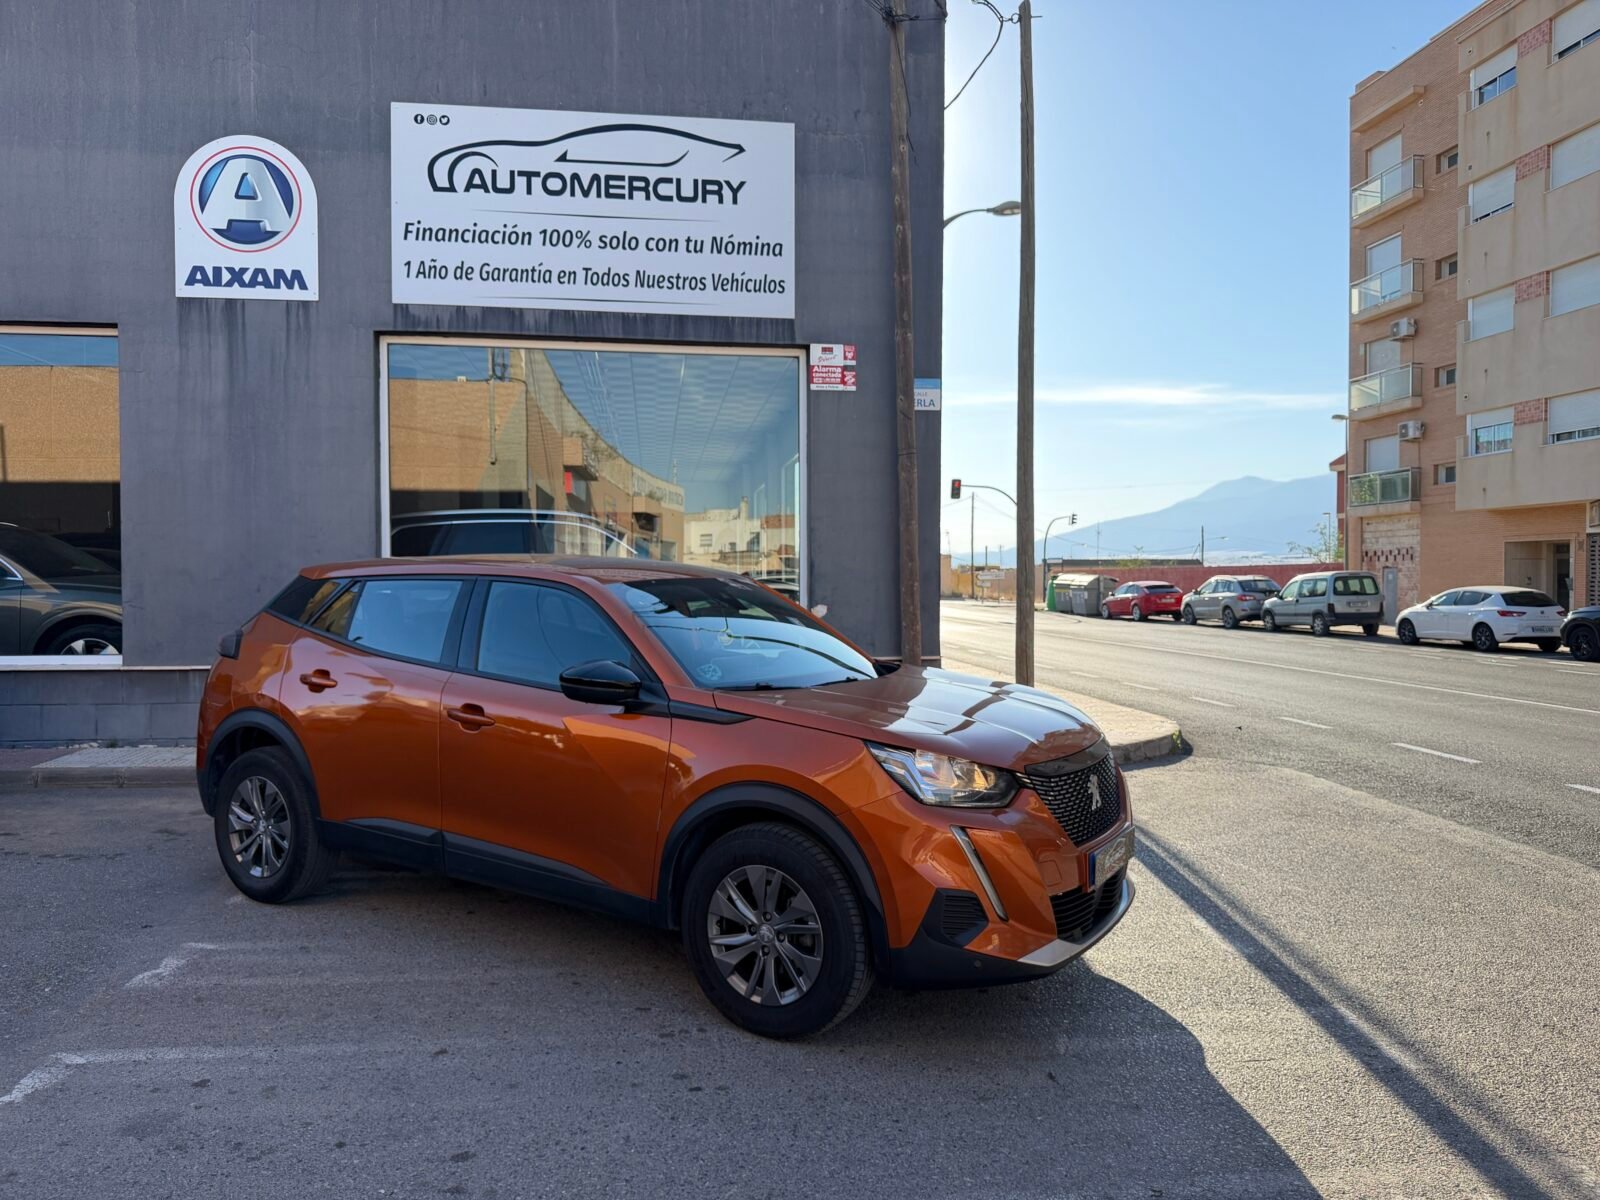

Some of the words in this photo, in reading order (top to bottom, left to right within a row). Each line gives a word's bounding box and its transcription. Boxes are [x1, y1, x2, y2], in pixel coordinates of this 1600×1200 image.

[463, 167, 747, 206] AUTOMERCURY
[403, 219, 533, 246] Financiación
[539, 228, 593, 249] 100%
[597, 230, 640, 251] solo
[644, 236, 679, 253] con
[684, 235, 705, 254] tu
[710, 233, 784, 258] Nómina
[184, 265, 309, 291] AIXAM
[403, 260, 412, 279] 1
[415, 258, 449, 280] Año
[453, 260, 475, 281] de
[479, 262, 553, 284] Garantía
[557, 269, 577, 285] en
[582, 266, 630, 288] Todos
[634, 269, 707, 292] Nuestros
[711, 271, 786, 295] Vehículos
[813, 365, 842, 373] Alarma
